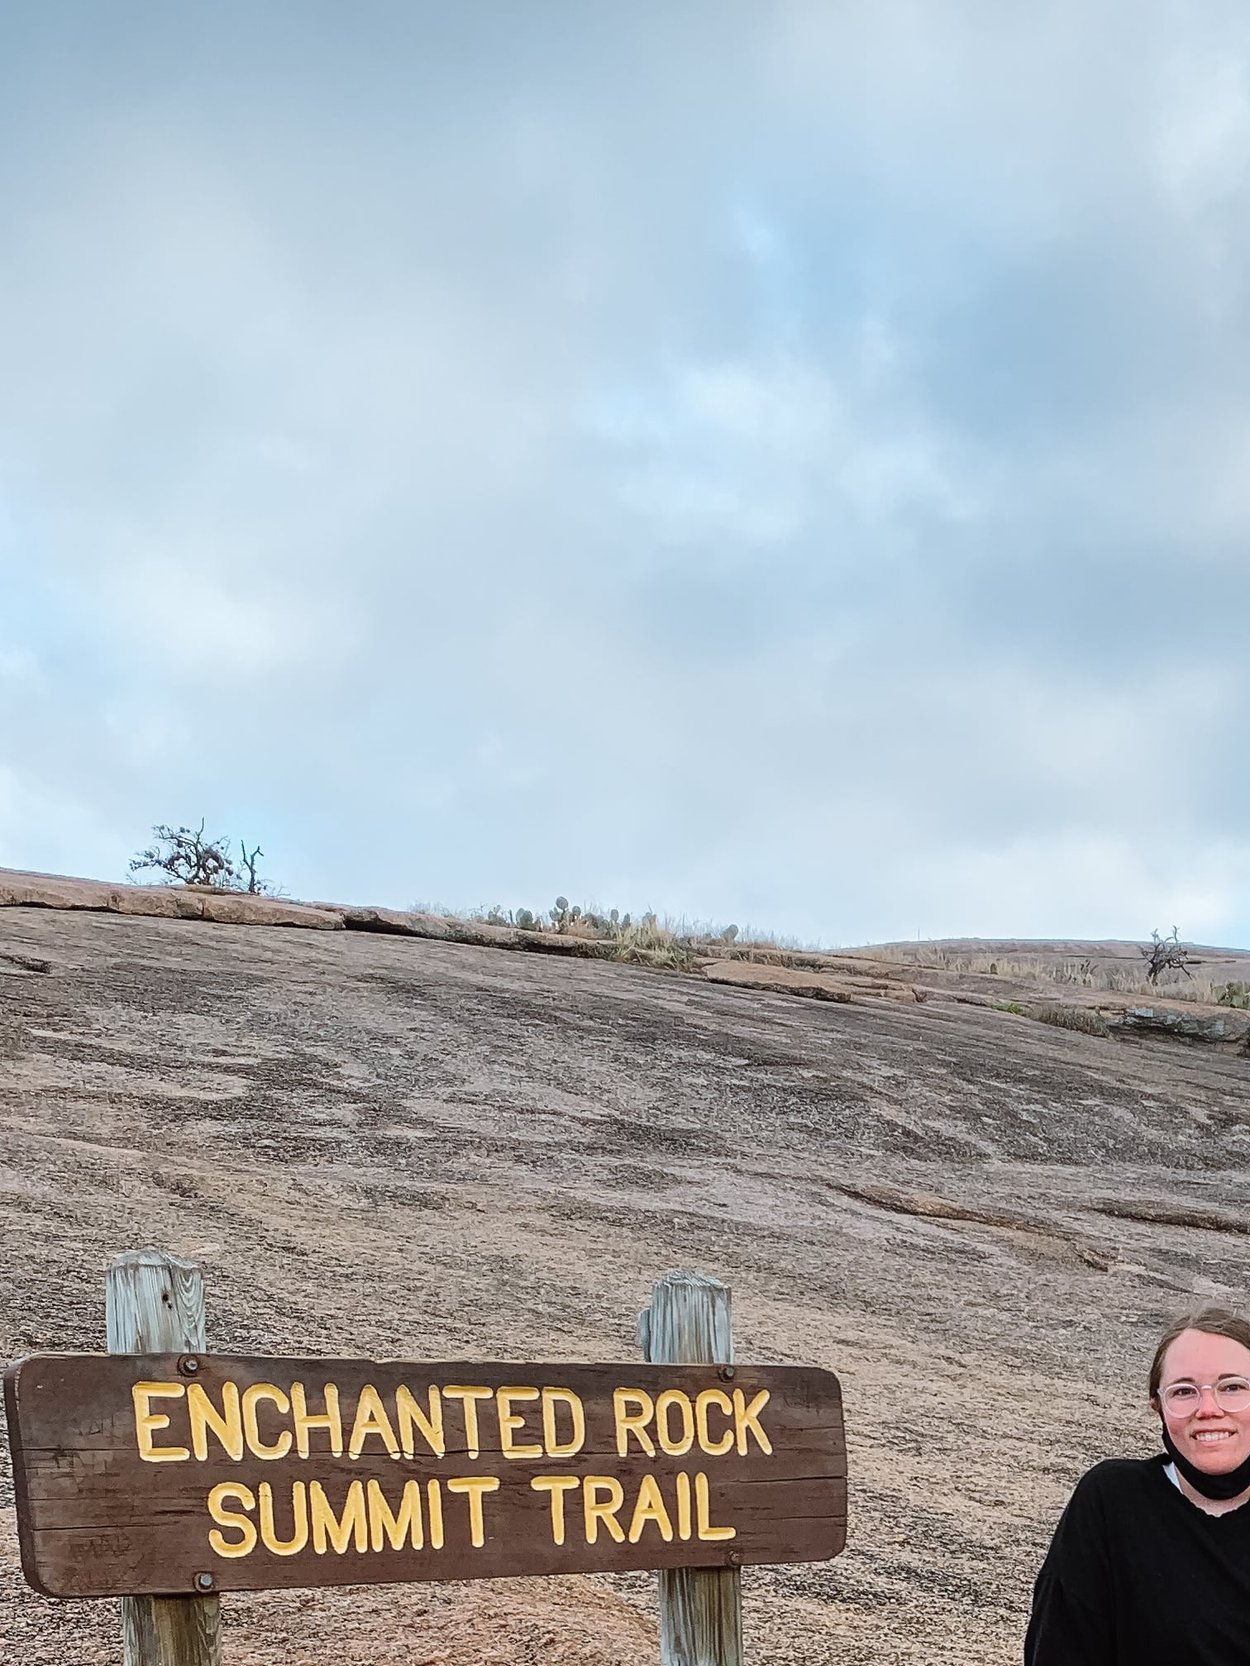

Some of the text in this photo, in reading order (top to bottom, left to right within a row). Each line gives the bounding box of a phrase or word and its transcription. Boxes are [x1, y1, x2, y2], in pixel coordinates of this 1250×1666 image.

[131, 1381, 772, 1462] ENCHANTED ROCK
[206, 1471, 737, 1559] SUMMIT TRAIL
